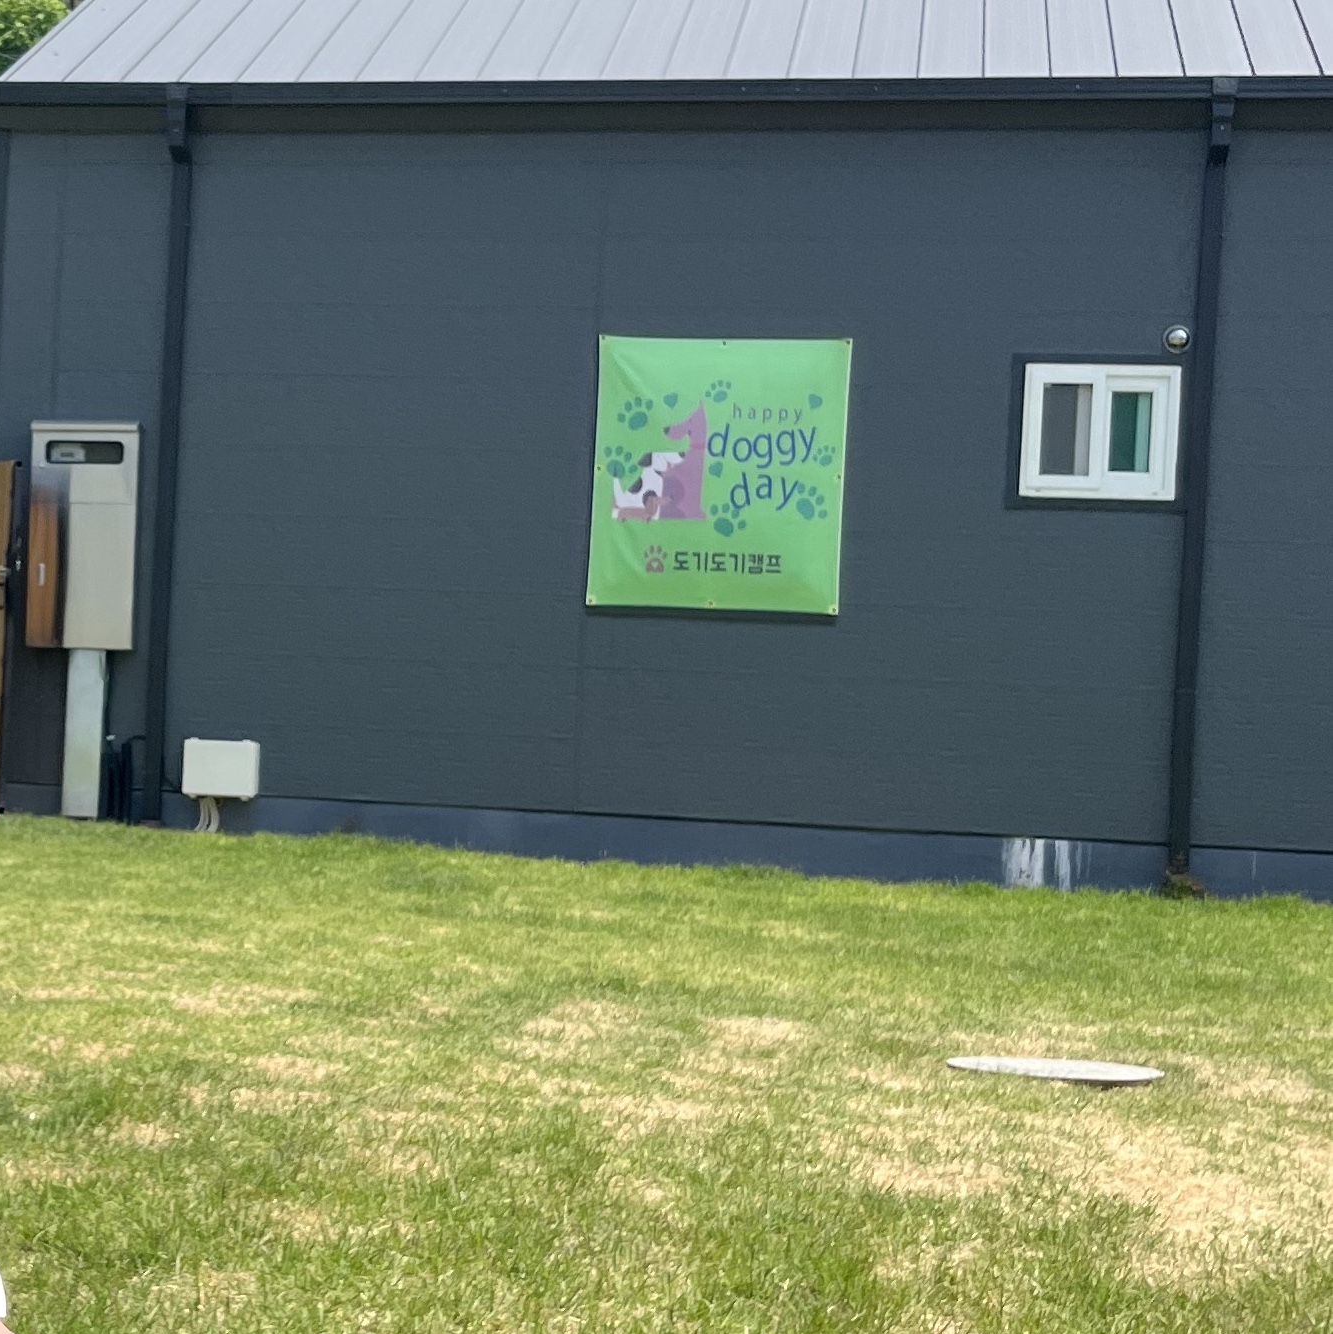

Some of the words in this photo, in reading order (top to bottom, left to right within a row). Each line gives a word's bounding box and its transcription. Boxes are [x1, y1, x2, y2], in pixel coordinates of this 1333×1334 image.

[732, 403, 803, 423] happy
[707, 423, 816, 469] doggy
[729, 472, 798, 511] day
[672, 550, 782, 574] 도기도기캠프
